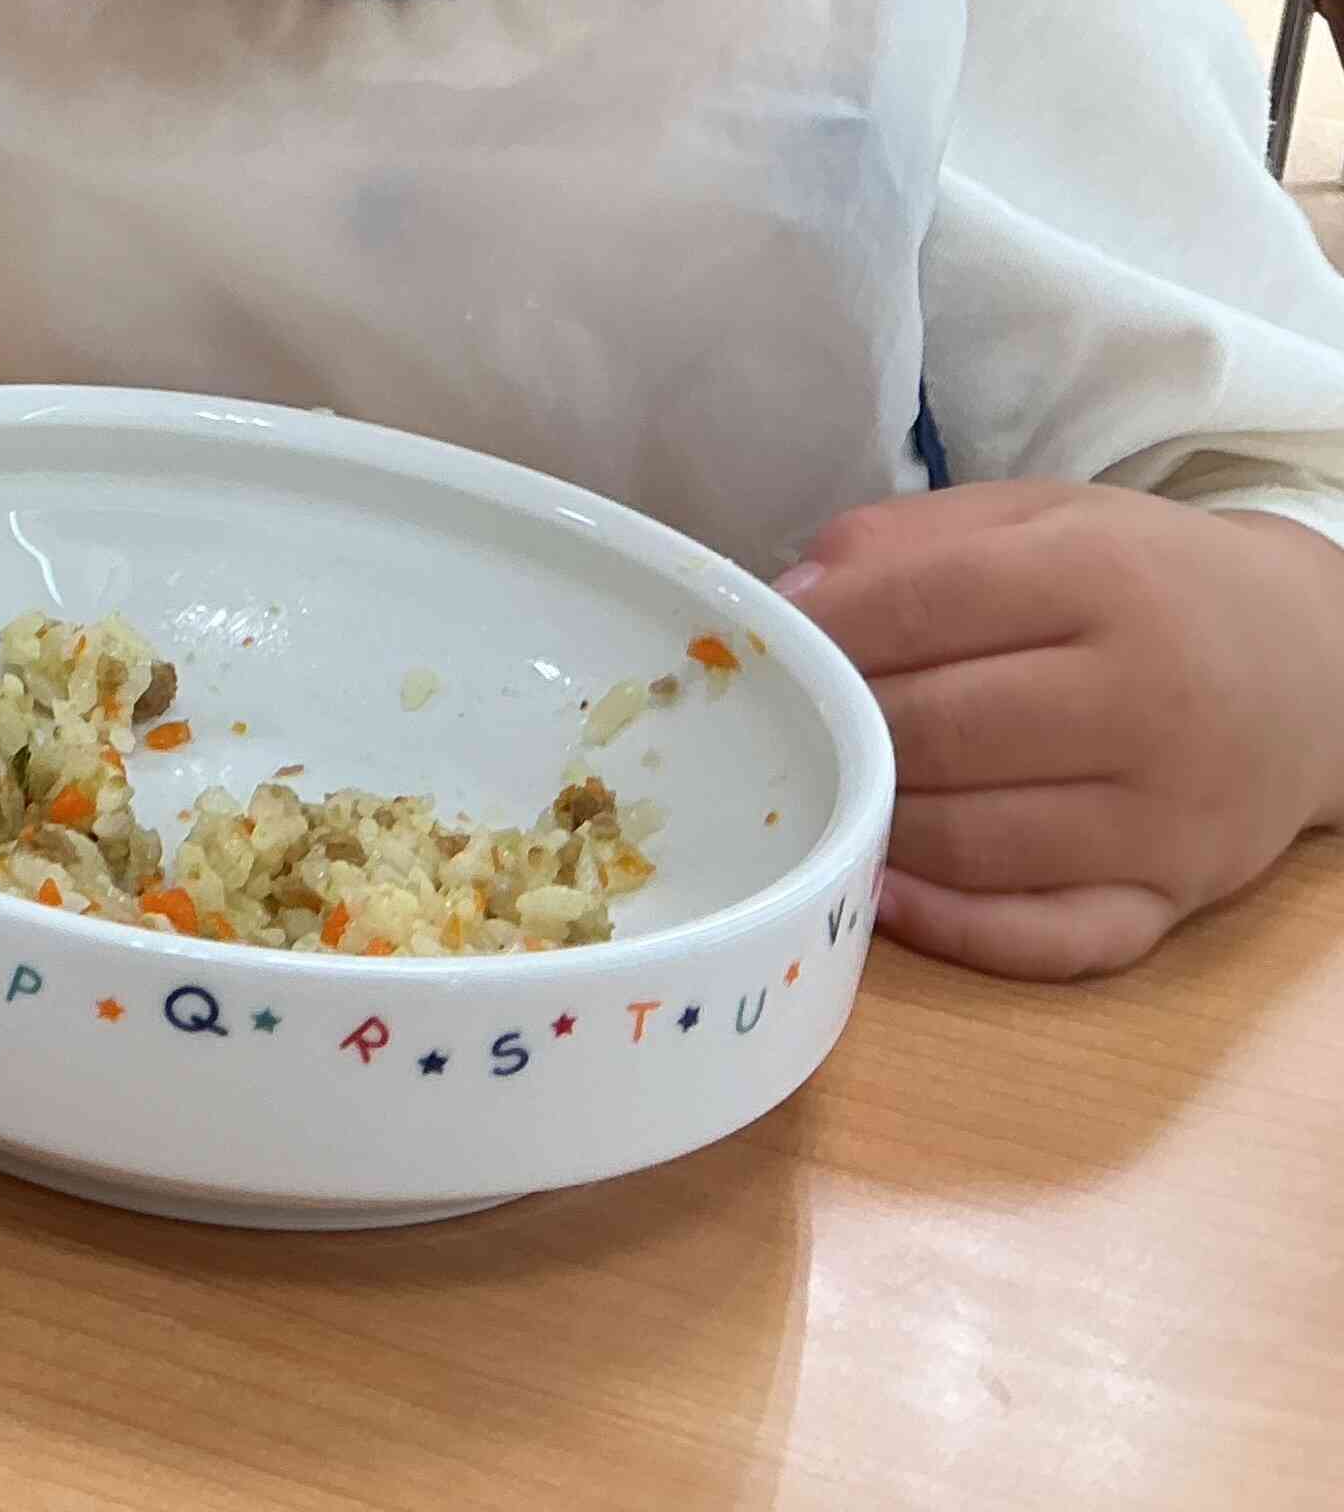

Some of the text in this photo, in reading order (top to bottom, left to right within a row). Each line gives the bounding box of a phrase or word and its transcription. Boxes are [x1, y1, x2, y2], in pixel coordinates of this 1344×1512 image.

[5, 963, 42, 1002] P
[163, 984, 230, 1037] Q
[338, 1014, 391, 1065] R
[490, 1030, 530, 1077] S
[625, 999, 662, 1044] T
[735, 986, 768, 1036] U
[828, 895, 846, 947] V
